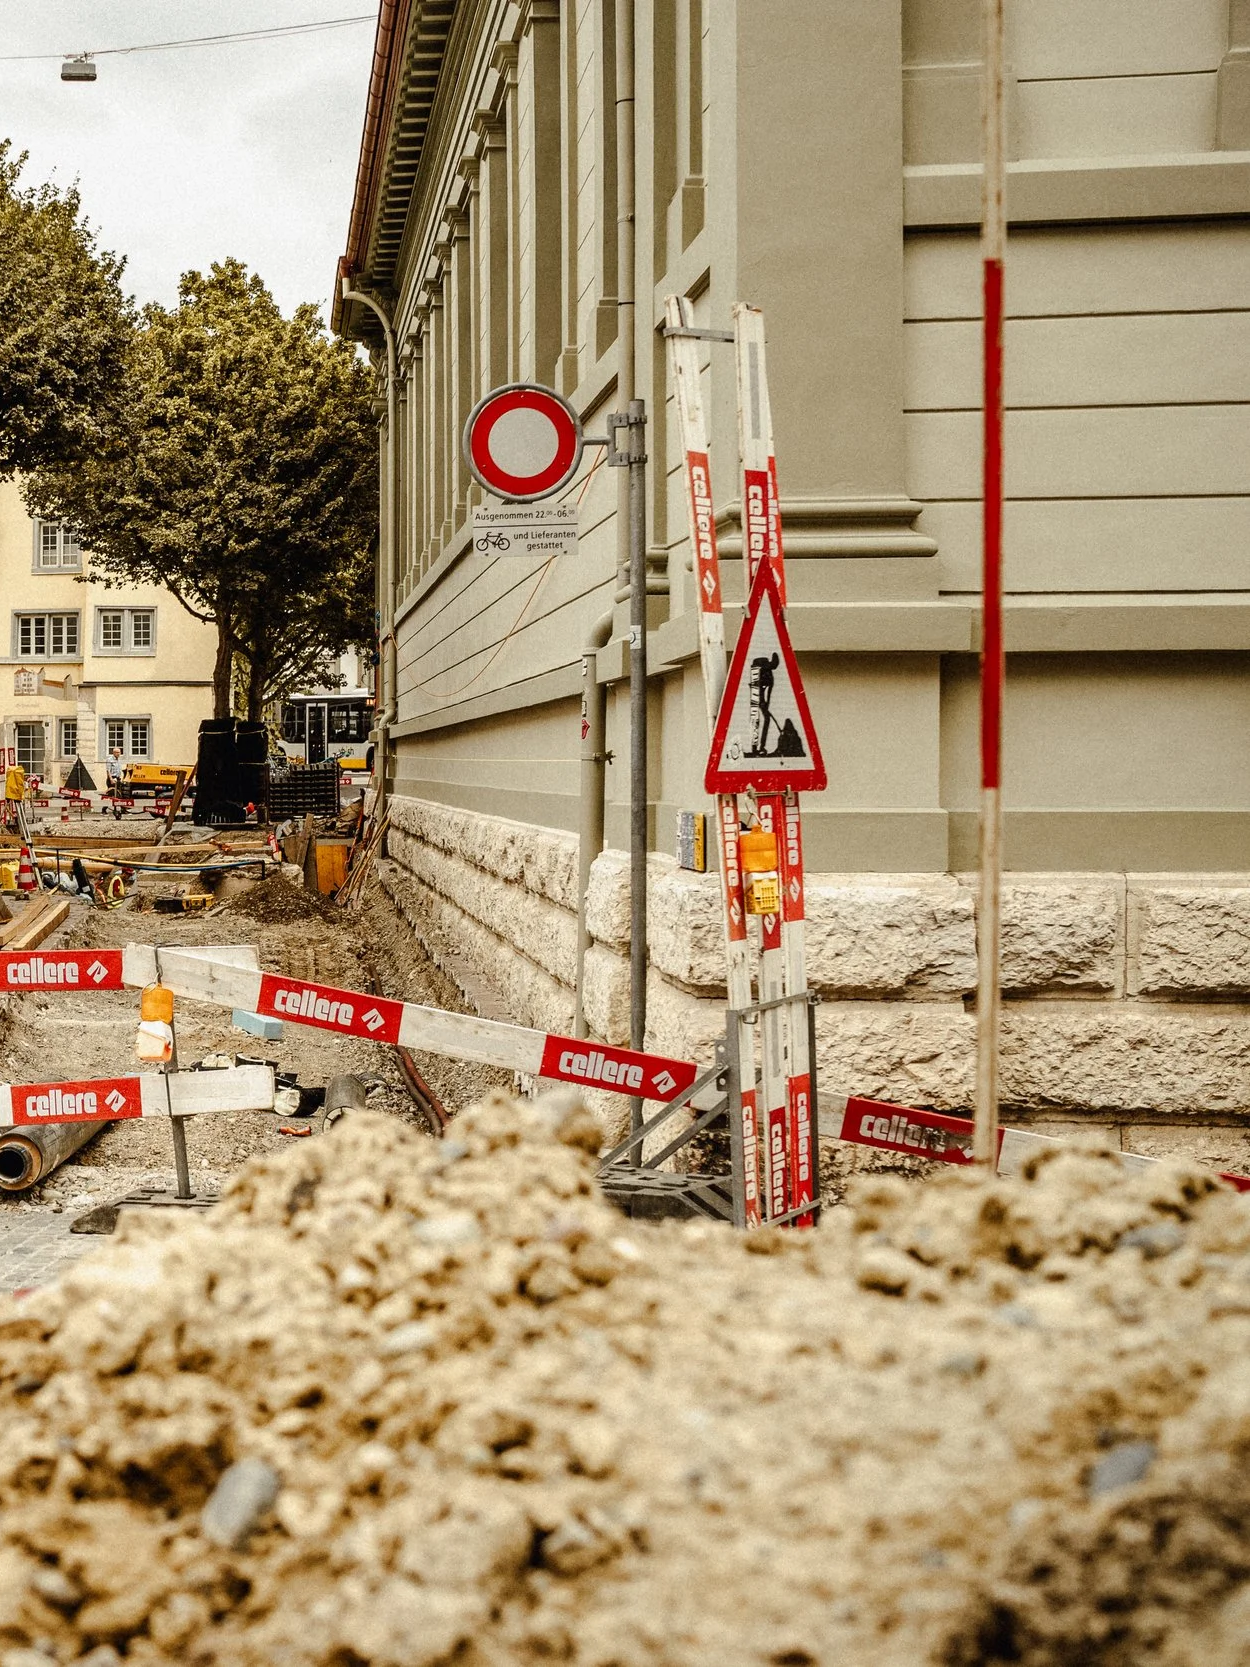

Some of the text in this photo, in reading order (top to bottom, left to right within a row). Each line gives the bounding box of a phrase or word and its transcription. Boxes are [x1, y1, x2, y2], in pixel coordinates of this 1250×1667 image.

[475, 510, 533, 522] Ausgenommen
[692, 465, 713, 560] cellere
[513, 531, 576, 540] und Lieferanten
[526, 542, 563, 551] gestattet
[786, 792, 800, 866] ellere
[7, 957, 79, 984] cellere
[273, 988, 354, 1026] cellere
[559, 1050, 643, 1089] cellere
[26, 1089, 97, 1117] cellere
[743, 1106, 756, 1200] cellere
[797, 1092, 810, 1181] cellere
[771, 1122, 785, 1216] cellere
